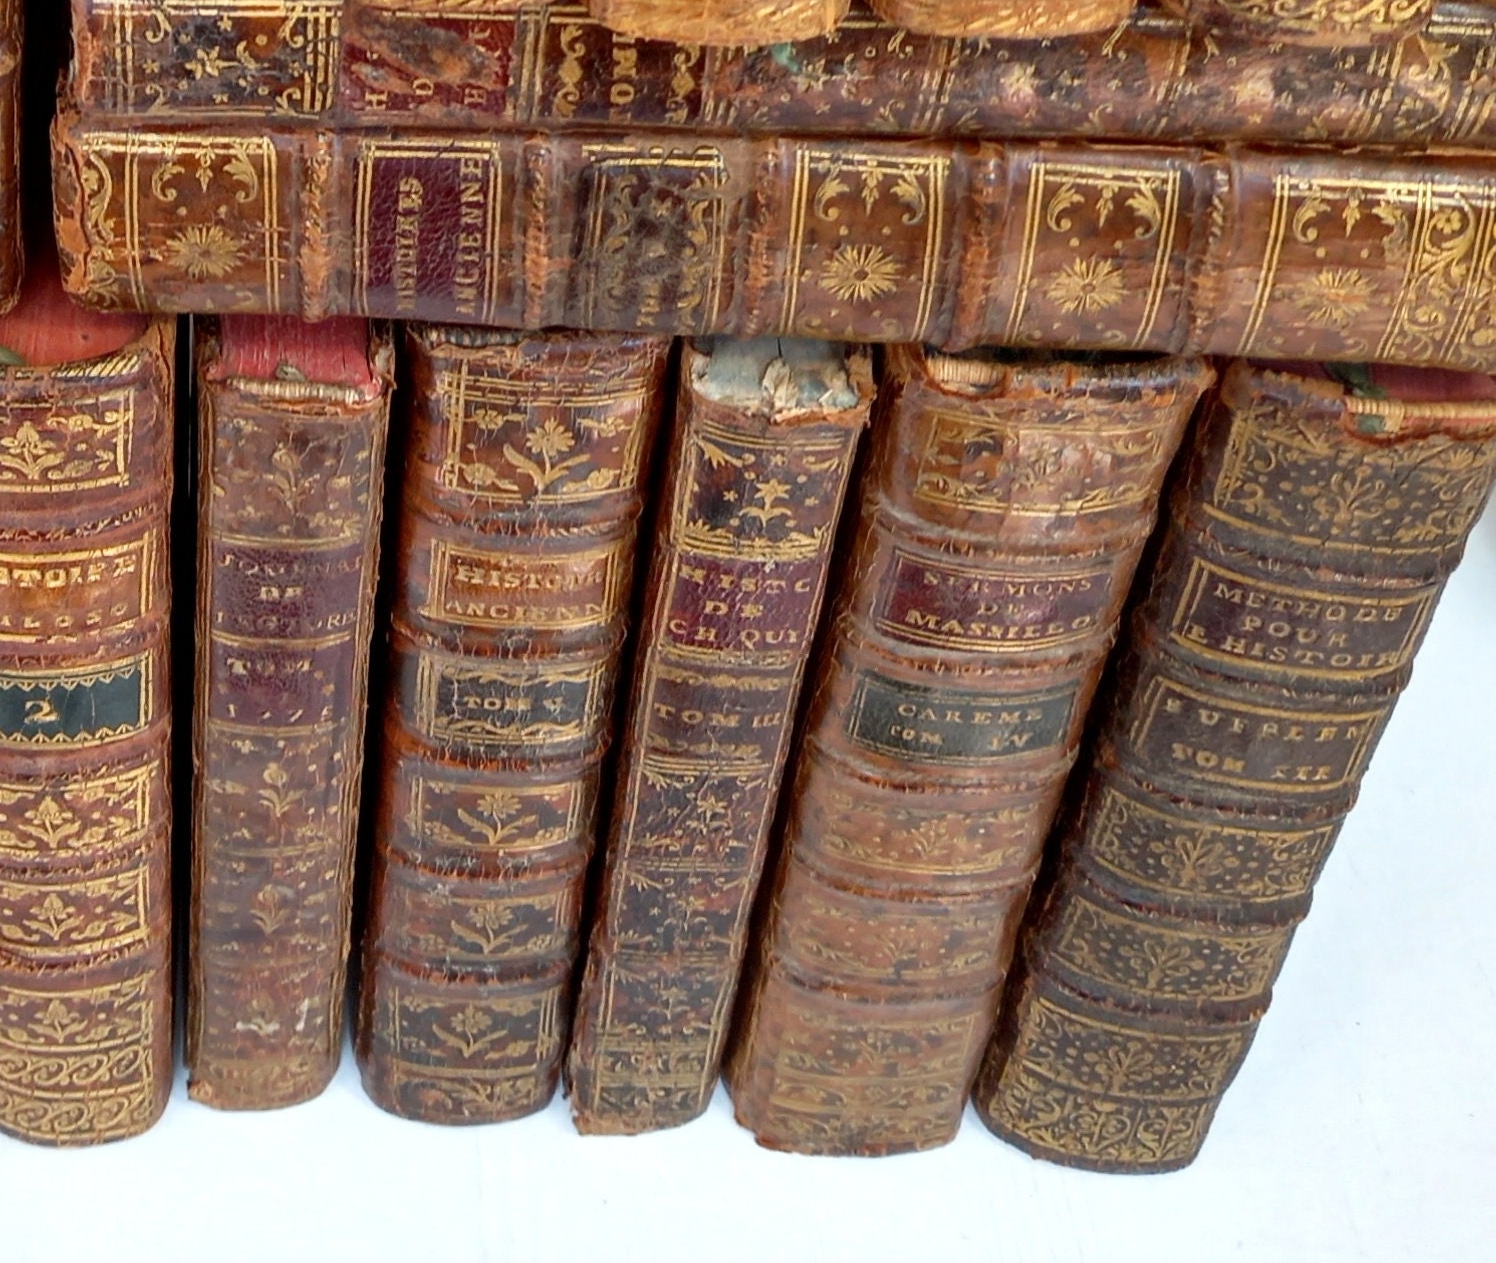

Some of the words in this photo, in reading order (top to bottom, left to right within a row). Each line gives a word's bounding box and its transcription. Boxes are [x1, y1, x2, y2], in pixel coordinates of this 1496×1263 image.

[455, 157, 485, 315] ANCIENNE
[1215, 584, 1404, 623] METHODE
[1241, 615, 1349, 648] POUR
[24, 699, 60, 725] 2
[462, 695, 531, 711] TOM
[654, 702, 740, 727] TOM
